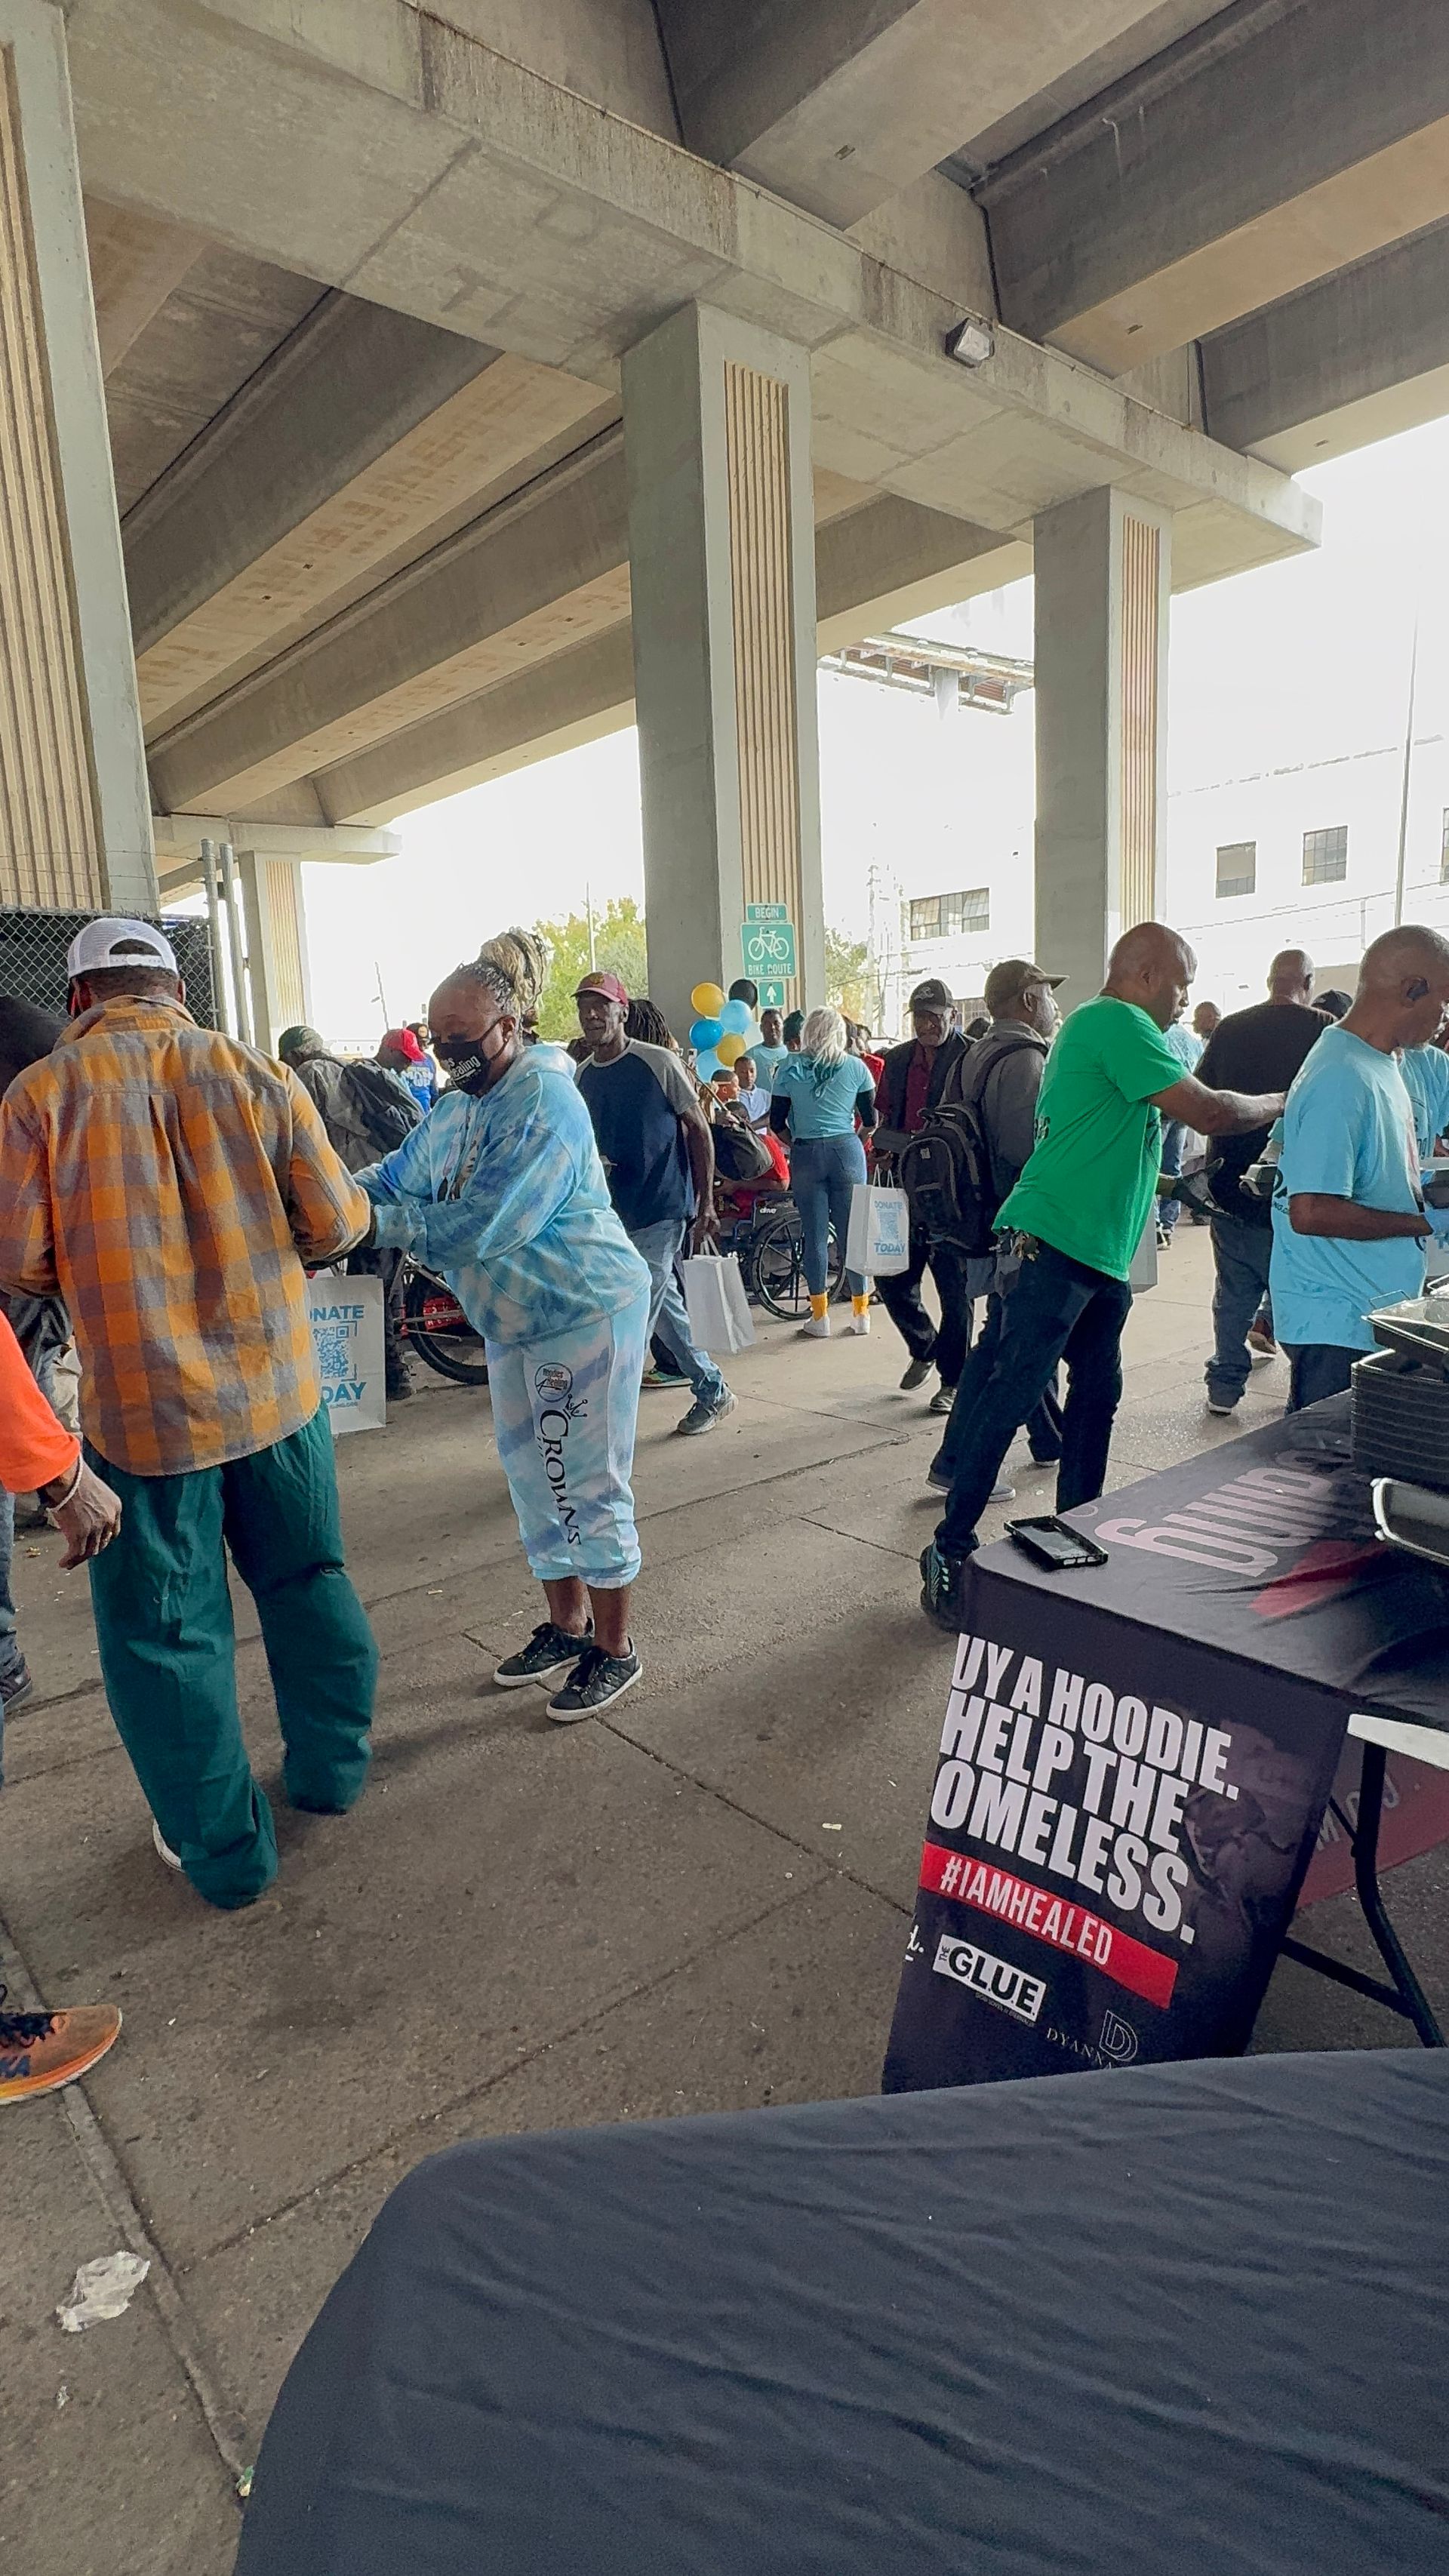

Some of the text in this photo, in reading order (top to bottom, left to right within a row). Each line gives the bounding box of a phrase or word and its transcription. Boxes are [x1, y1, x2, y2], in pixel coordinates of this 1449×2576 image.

[755, 907, 780, 919] BEGIN
[748, 963, 792, 975] BIKE ROUTE
[452, 1055, 481, 1078] ealing
[874, 1200, 903, 1210] DONATE
[874, 1242, 906, 1253] TODAY
[309, 1305, 365, 1322] NATE
[321, 1381, 367, 1403] DAY
[951, 1633, 1240, 1801] UY A HOODIE.
[940, 1689, 1074, 1792] HELP
[1082, 1740, 1190, 1854] THE
[931, 1759, 1197, 1945] OMELESS.
[939, 1854, 1113, 1966] #IAMHEALED
